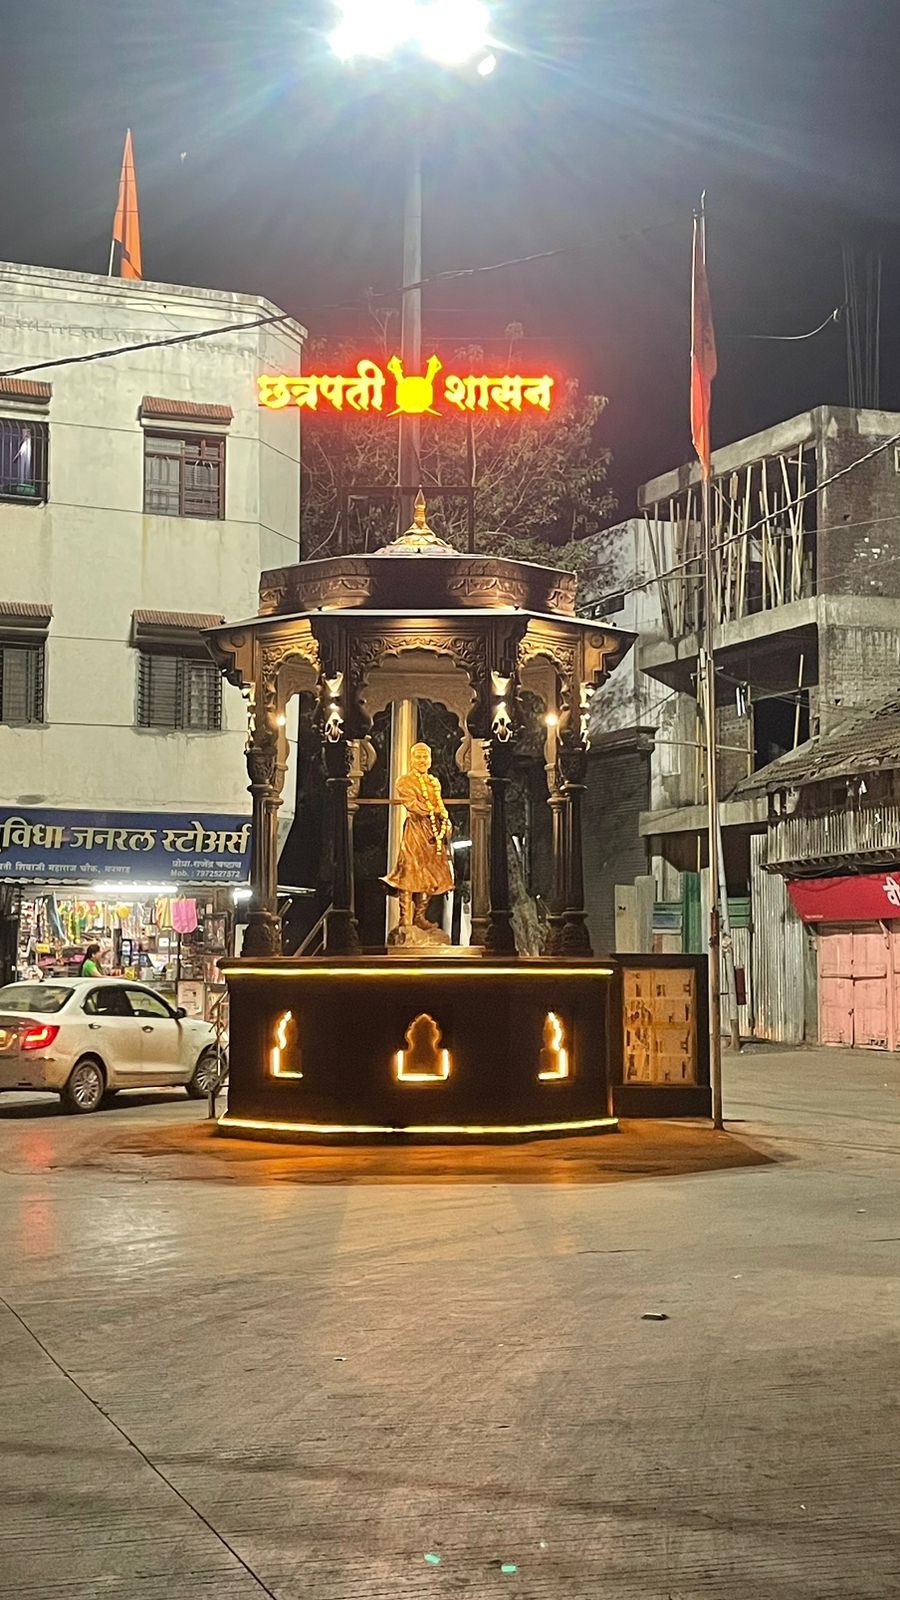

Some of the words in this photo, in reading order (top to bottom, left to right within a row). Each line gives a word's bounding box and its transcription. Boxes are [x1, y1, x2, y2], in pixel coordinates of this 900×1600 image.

[257, 359, 386, 411] छत्रपती
[444, 374, 554, 411] शासन
[0, 816, 65, 852] विधा
[70, 826, 157, 852] जनरल
[161, 821, 252, 854] स्टोअर्स
[15, 861, 45, 872] शिवाजी
[48, 863, 77, 873] महाराज
